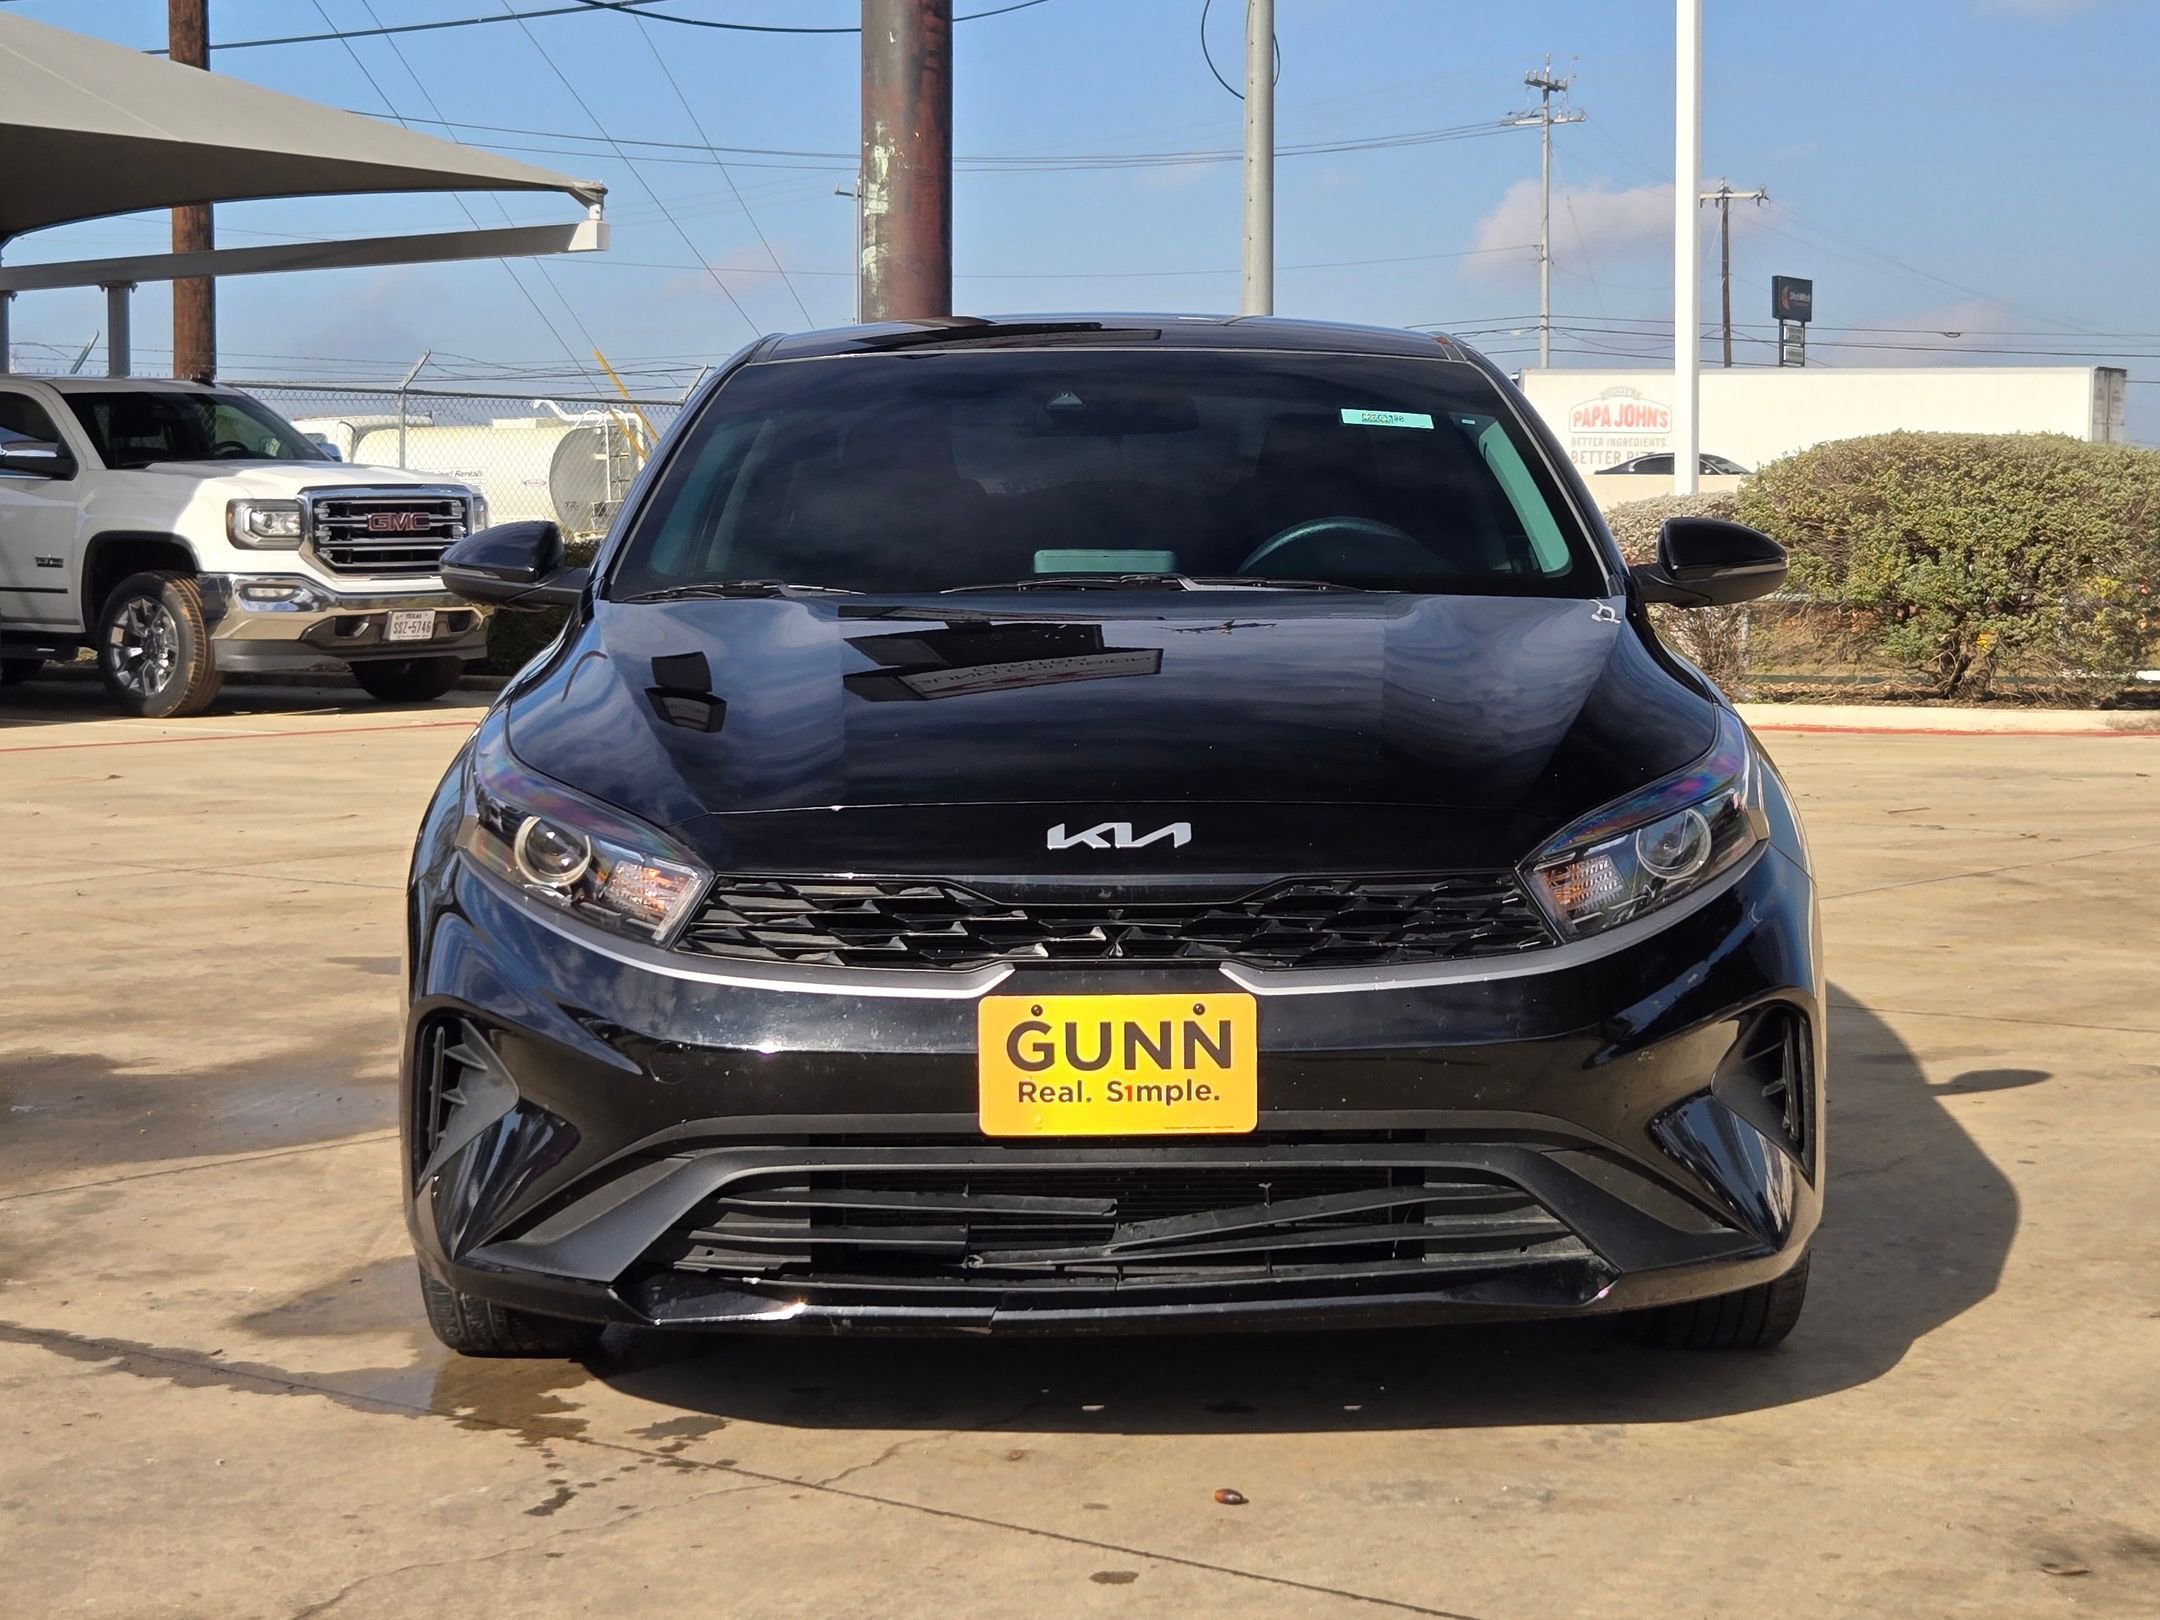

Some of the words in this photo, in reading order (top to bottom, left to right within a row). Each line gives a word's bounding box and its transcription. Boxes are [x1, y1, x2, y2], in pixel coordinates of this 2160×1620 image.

[1573, 404, 1611, 427] PAPA
[1614, 403, 1668, 428] JOHN'S
[1571, 437, 1603, 447] BETTER
[1571, 450, 1621, 464] BETTER
[368, 512, 430, 531] GMC
[1006, 1020, 1231, 1072] GUNN
[1018, 1080, 1092, 1103] Real.
